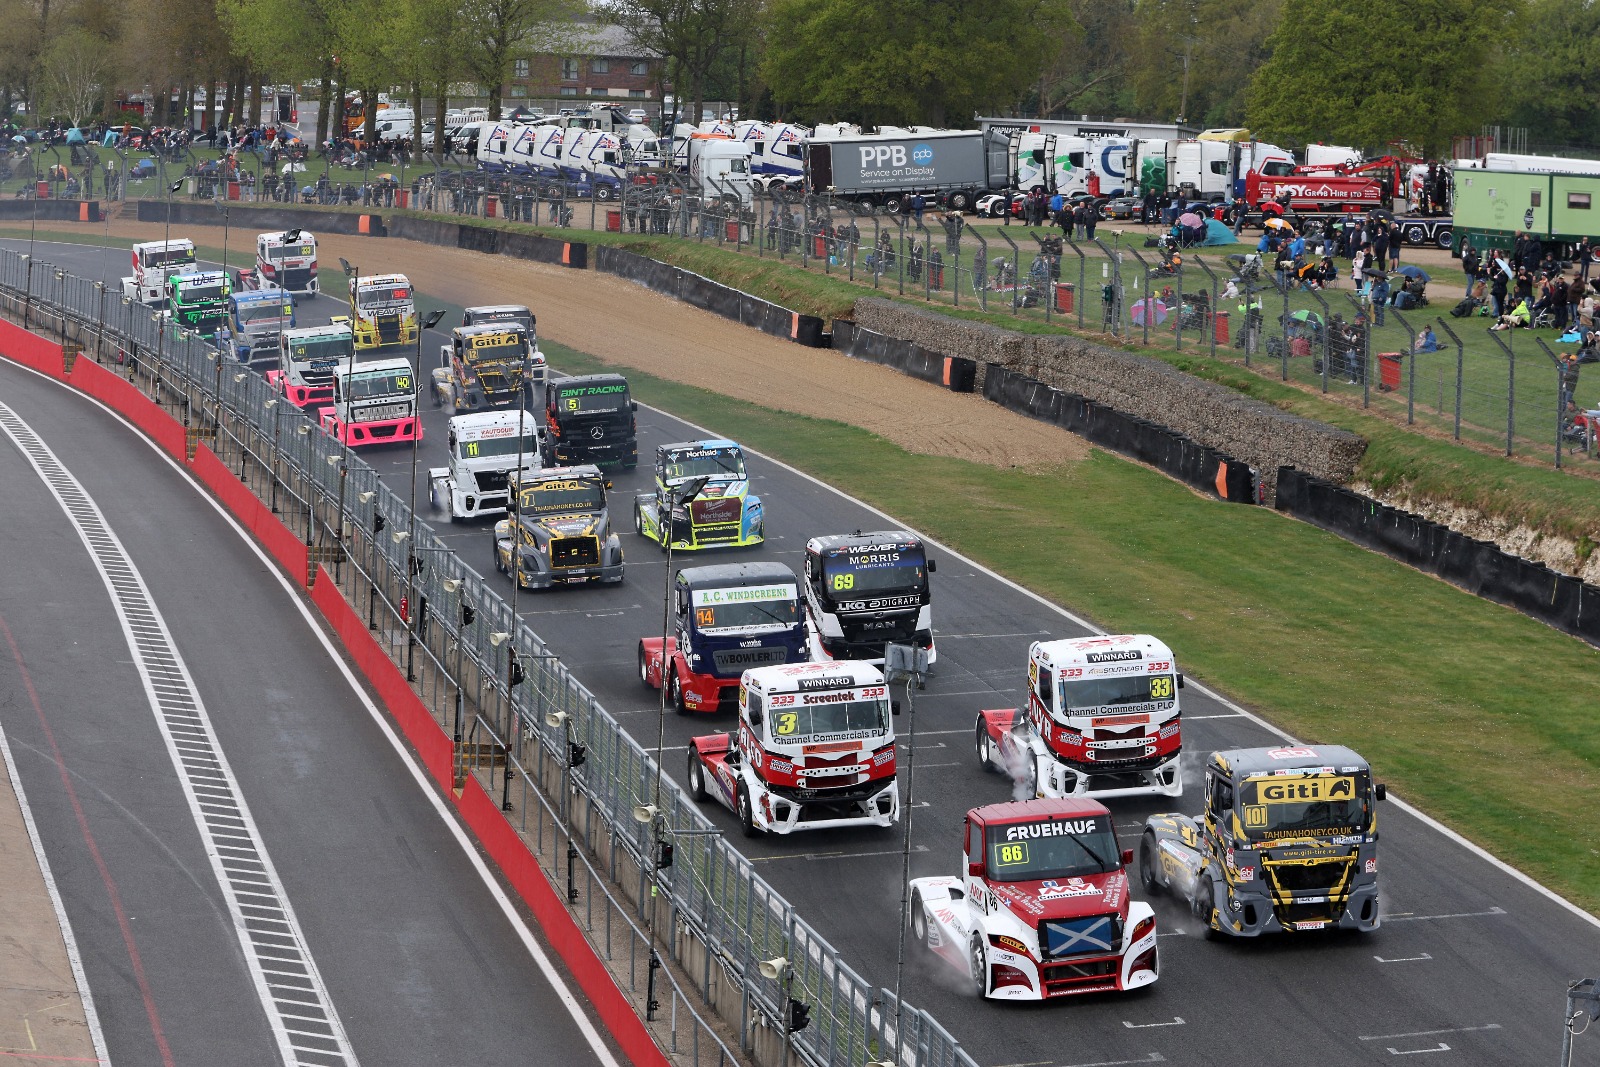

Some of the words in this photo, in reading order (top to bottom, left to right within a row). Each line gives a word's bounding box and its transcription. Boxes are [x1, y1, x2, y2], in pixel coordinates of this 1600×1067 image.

[859, 145, 907, 168] PPB
[913, 148, 932, 161] ppb
[860, 169, 890, 178] Service
[905, 166, 935, 176] Display
[1275, 184, 1306, 197] MSY
[1330, 189, 1348, 198] HIRE
[394, 290, 406, 299] 96
[367, 307, 408, 317] WEAVER
[475, 337, 502, 347] Giti
[469, 350, 478, 360] 12
[587, 385, 626, 395] RACING
[568, 399, 577, 409] 5
[467, 443, 478, 456] 11
[524, 495, 530, 506] 7
[848, 543, 897, 553] WEAVER
[849, 553, 900, 565] MORRIS
[834, 573, 854, 590] 69
[726, 588, 788, 600] WINDSCREENS
[881, 596, 920, 607] DIGRAPH
[698, 611, 712, 624] 14
[863, 621, 896, 631] MAN
[1092, 652, 1137, 662] WINNARD
[1060, 668, 1082, 677] 333
[1147, 662, 1169, 671] 333
[803, 678, 850, 687] WINNARD
[1151, 678, 1170, 698] 33
[803, 691, 855, 705] Screentek
[862, 688, 884, 697] 333
[772, 695, 795, 705] 333
[1063, 706, 1098, 717] Channel
[1100, 702, 1156, 714] Commercials
[1157, 700, 1174, 710] PLC
[778, 713, 797, 735] 3
[774, 736, 811, 745] Channel
[813, 732, 870, 742] Commercials
[871, 728, 889, 739] PLC
[1263, 783, 1319, 799] Giti
[1246, 807, 1266, 825] 101
[1006, 820, 1096, 841] FRUEHAUF
[1263, 827, 1352, 839] TAHUNAHONEY.CO.UK
[1001, 845, 1023, 863] 86
[1039, 889, 1102, 900] Commercial
